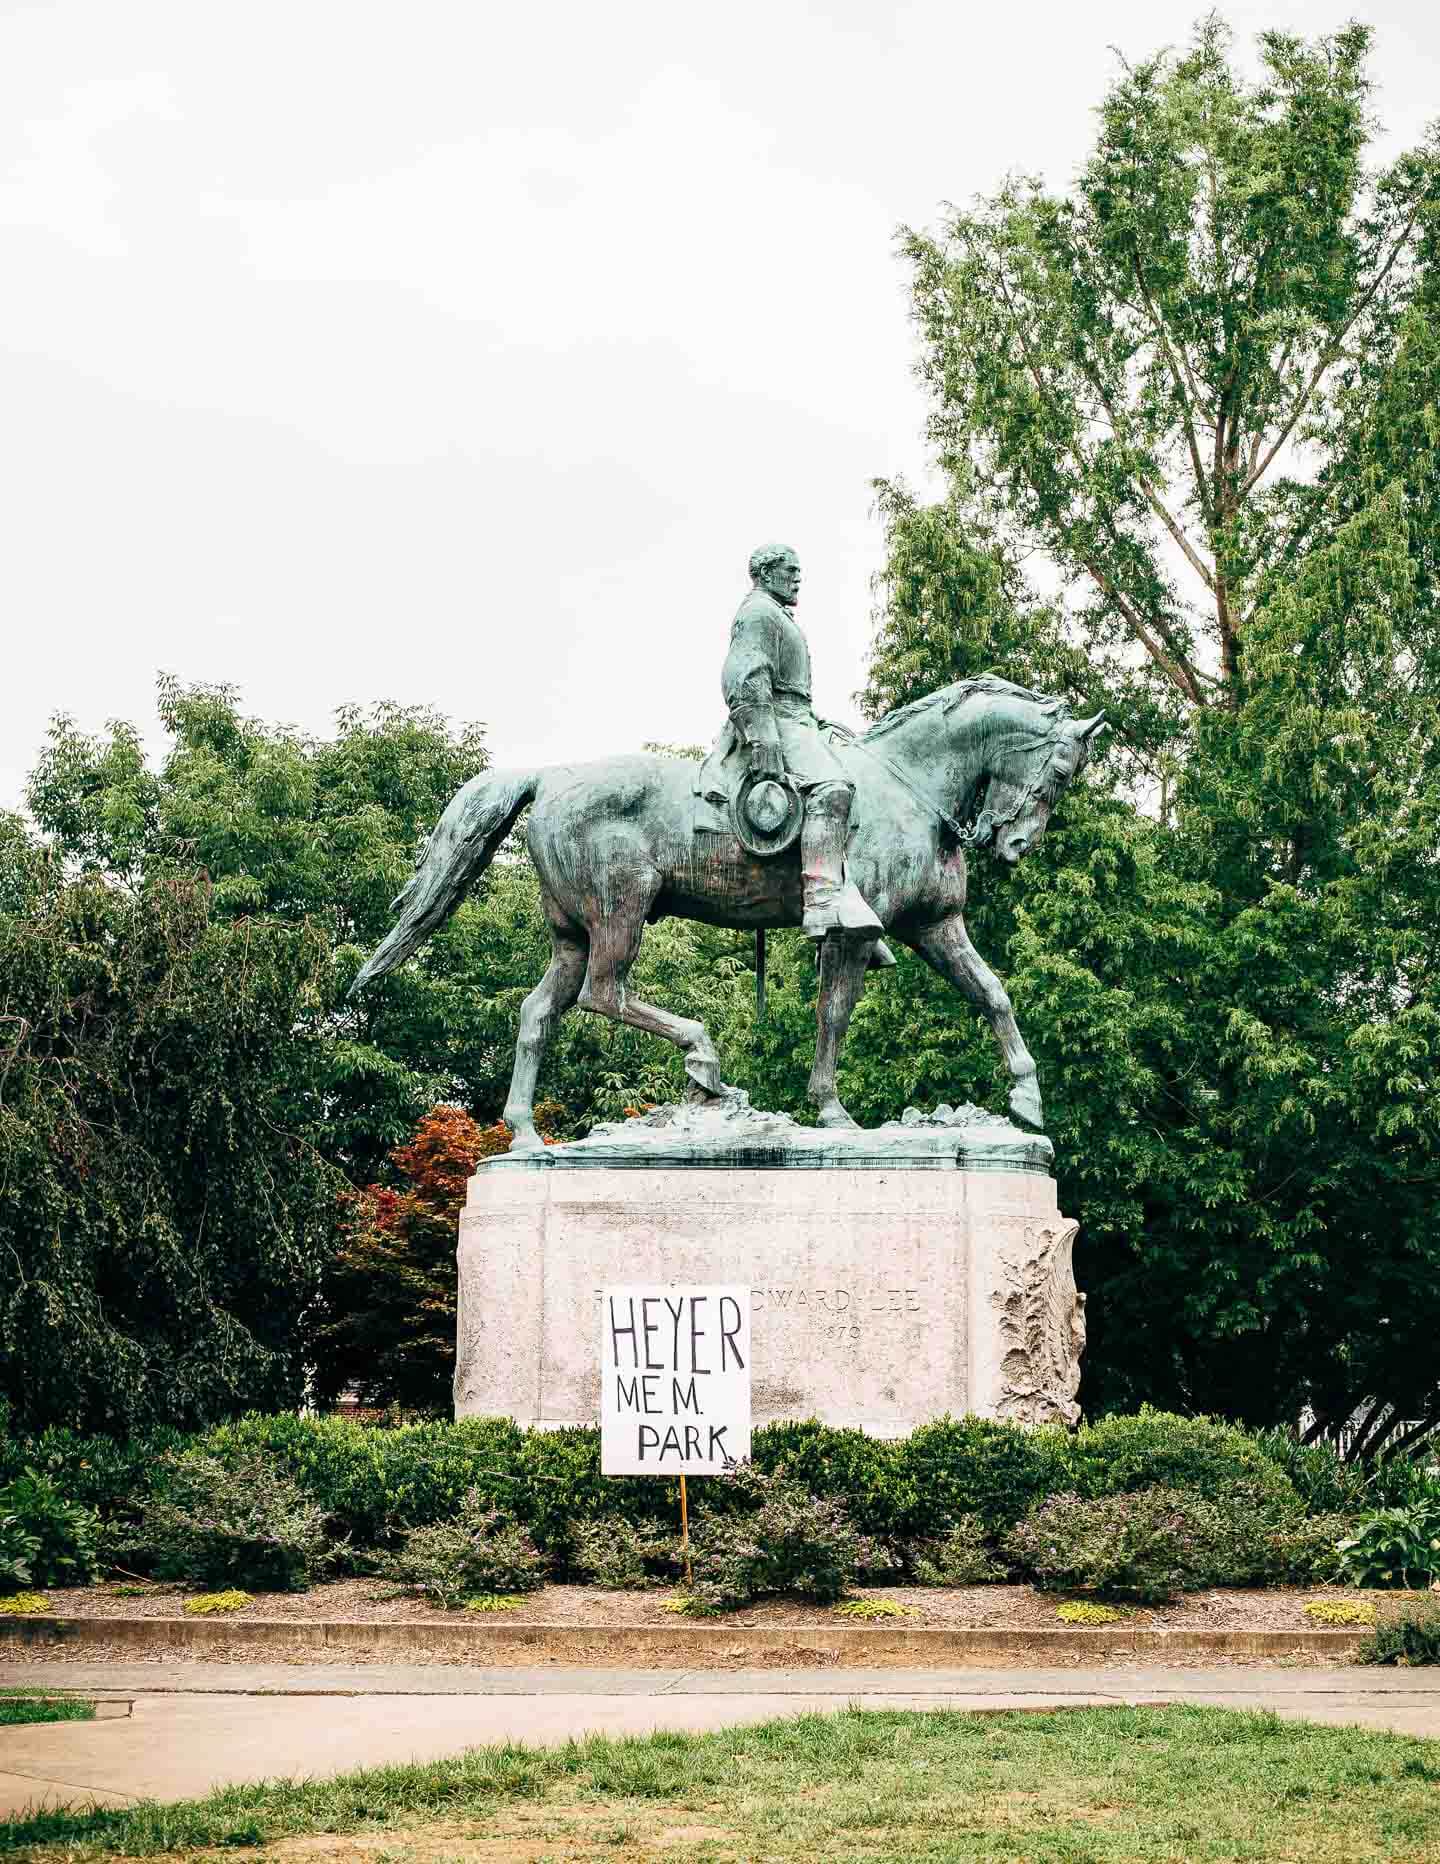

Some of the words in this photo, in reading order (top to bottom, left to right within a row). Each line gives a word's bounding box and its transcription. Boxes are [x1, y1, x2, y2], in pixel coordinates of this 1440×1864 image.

[751, 1290, 850, 1311] DWARD
[870, 1290, 921, 1311] LEE
[610, 1295, 745, 1374] HEYER
[821, 1326, 861, 1339] 870
[638, 1424, 729, 1461] PARK
